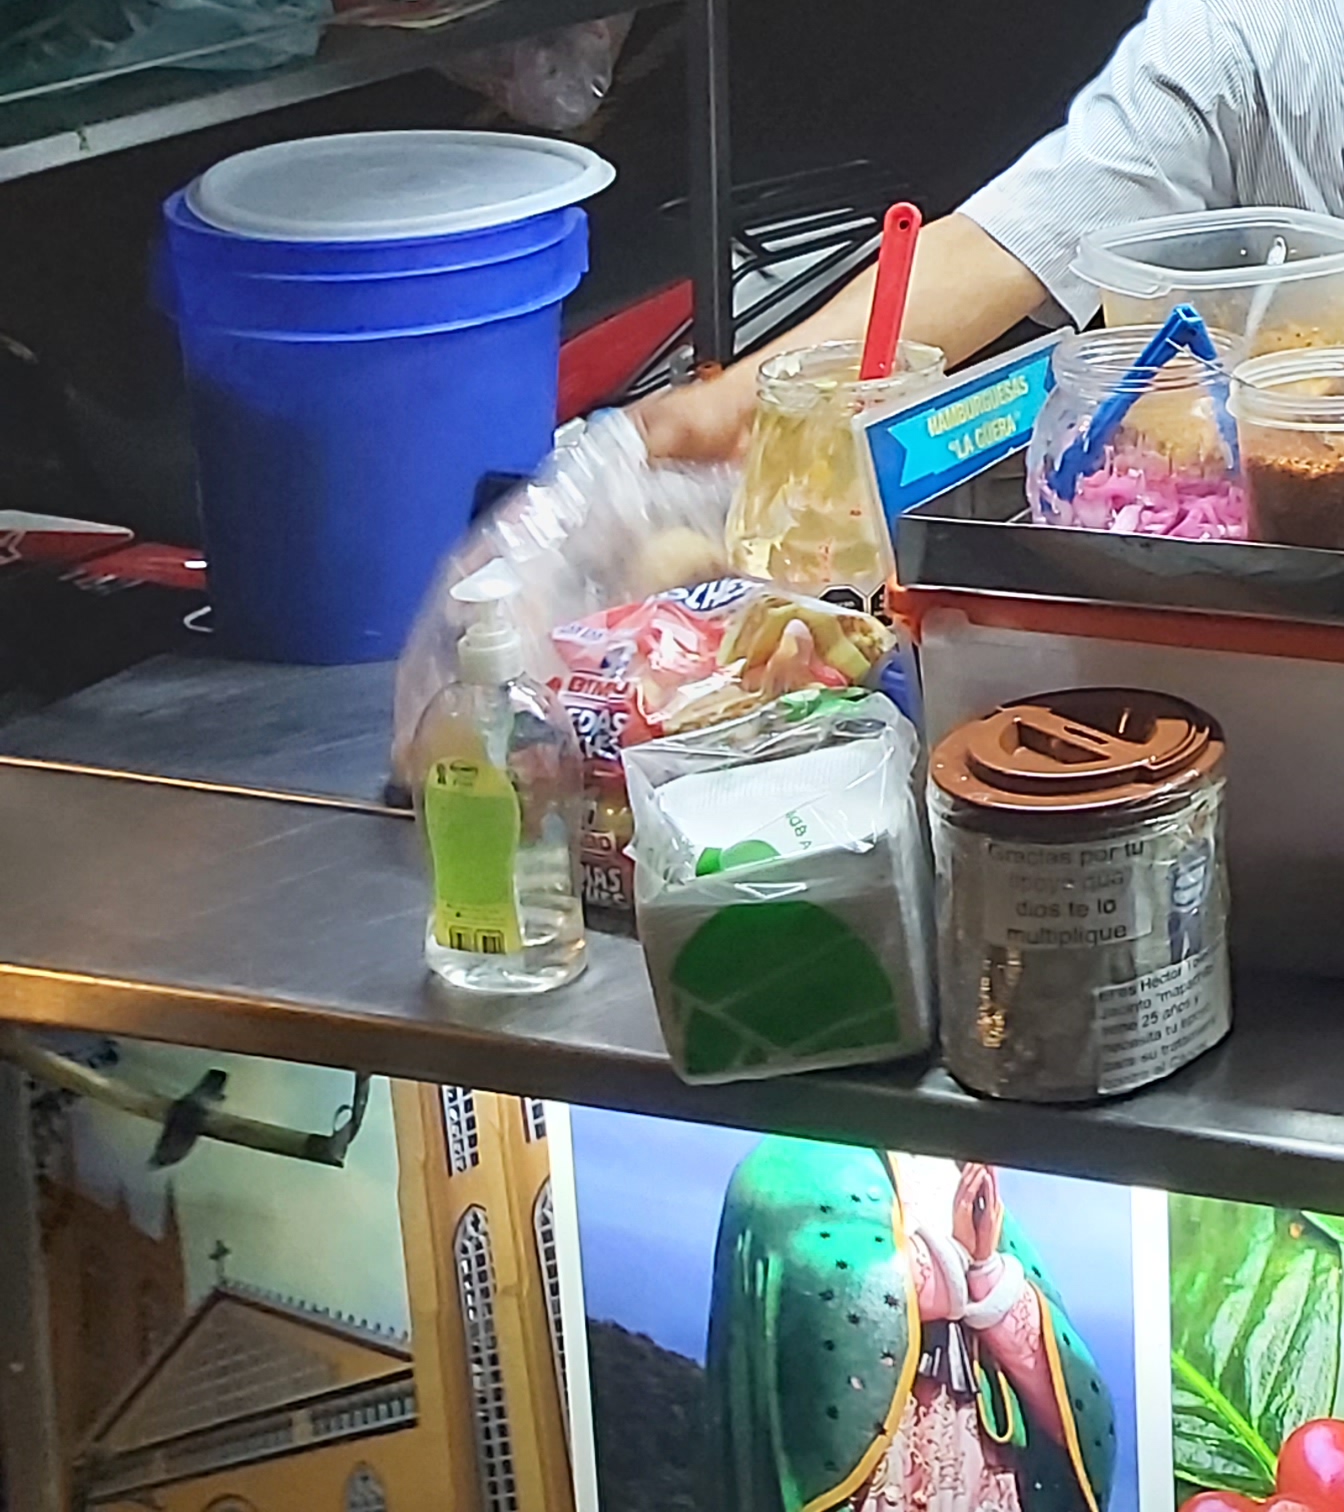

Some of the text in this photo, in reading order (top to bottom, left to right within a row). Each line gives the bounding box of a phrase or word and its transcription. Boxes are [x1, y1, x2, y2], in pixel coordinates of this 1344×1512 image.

[1124, 840, 1145, 858] tu
[1015, 898, 1118, 918] dios te lo
[1141, 1010, 1159, 1029] 25
